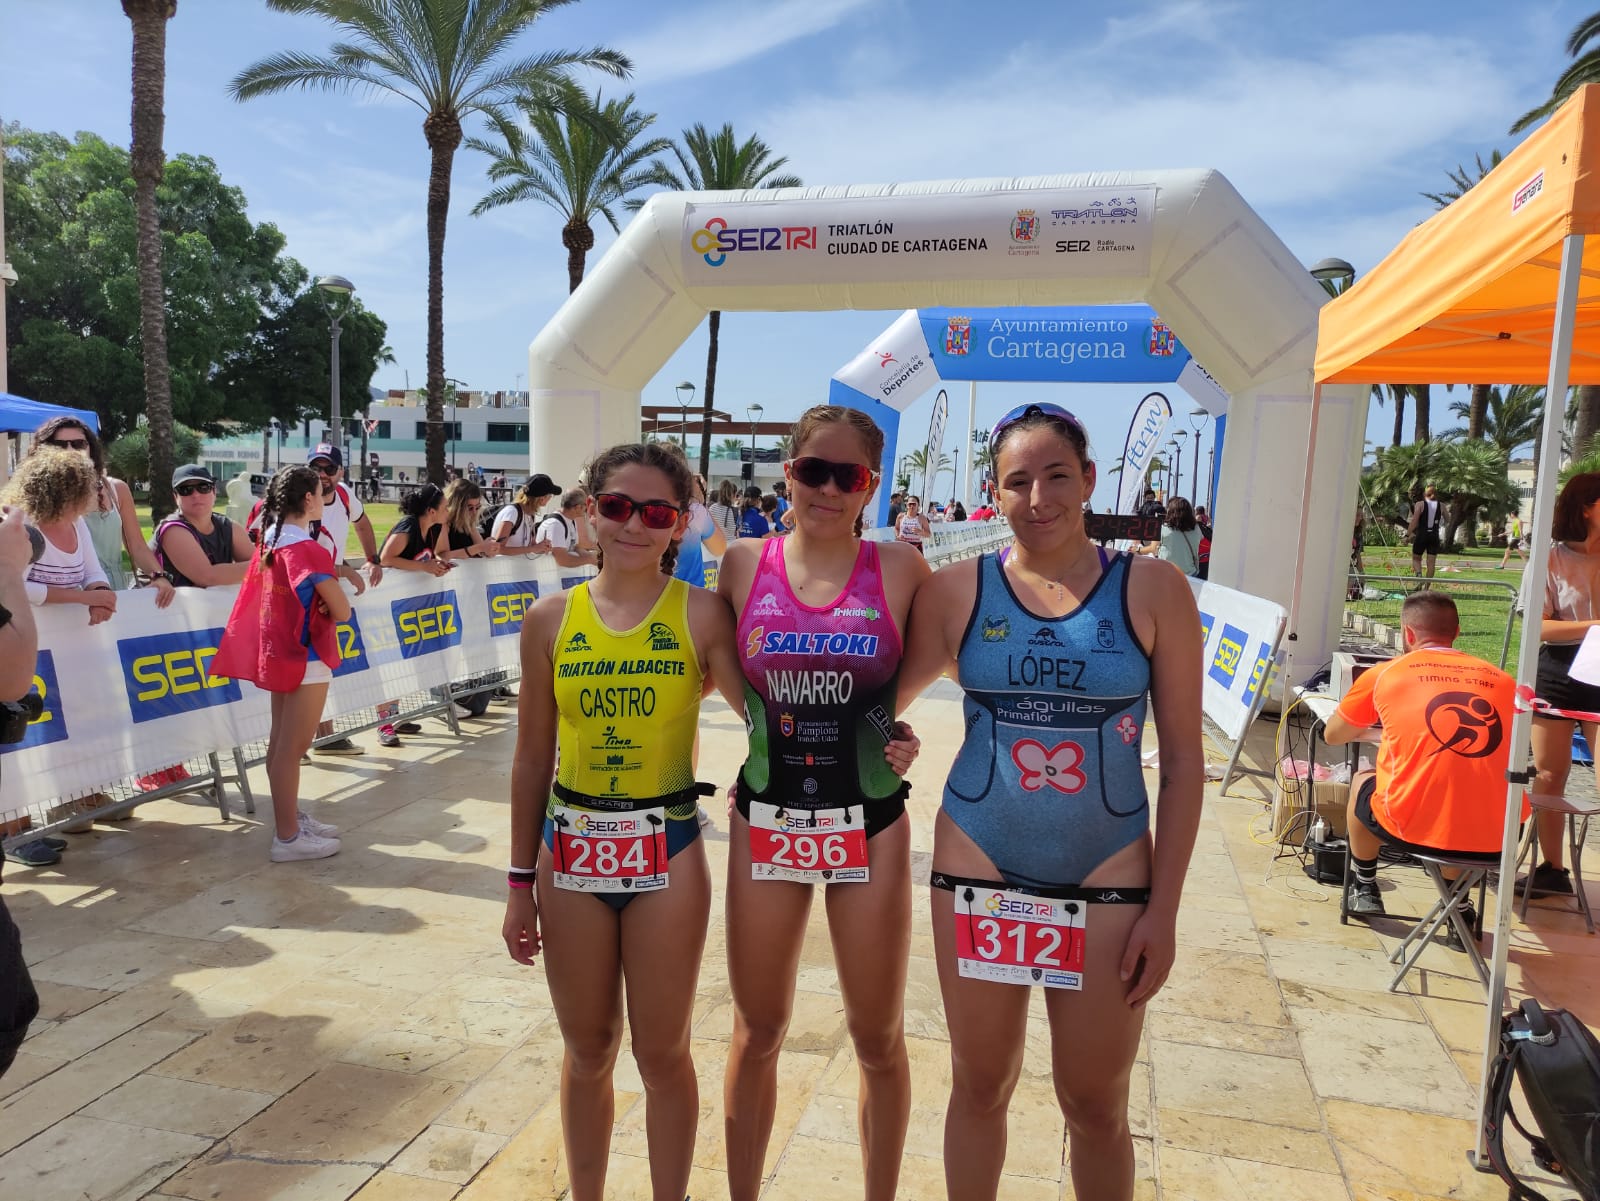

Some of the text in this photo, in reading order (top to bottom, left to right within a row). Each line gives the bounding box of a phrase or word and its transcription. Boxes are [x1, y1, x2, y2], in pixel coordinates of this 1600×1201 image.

[828, 221, 894, 237] TRIATLÓN
[828, 238, 988, 256] CIUDAD DE CARTAGENA
[1055, 240, 1091, 252] SER
[990, 318, 1129, 336] Ayuntamiento
[987, 336, 1127, 365] Cartagena
[883, 360, 924, 396] Deportes
[399, 604, 458, 645] SER
[763, 631, 878, 657] SALTOKI
[558, 658, 685, 678] TRIATLÓN ALBACETE
[1008, 649, 1087, 691] LÓPEZ
[765, 669, 853, 705] NAVARRO
[580, 686, 656, 718] CASTRO
[997, 707, 1054, 722] Primaflor
[1016, 696, 1106, 713] águilas
[797, 726, 839, 738] Pamplona
[569, 838, 649, 875] 284
[769, 833, 848, 868] 296
[976, 918, 1062, 967] 312
